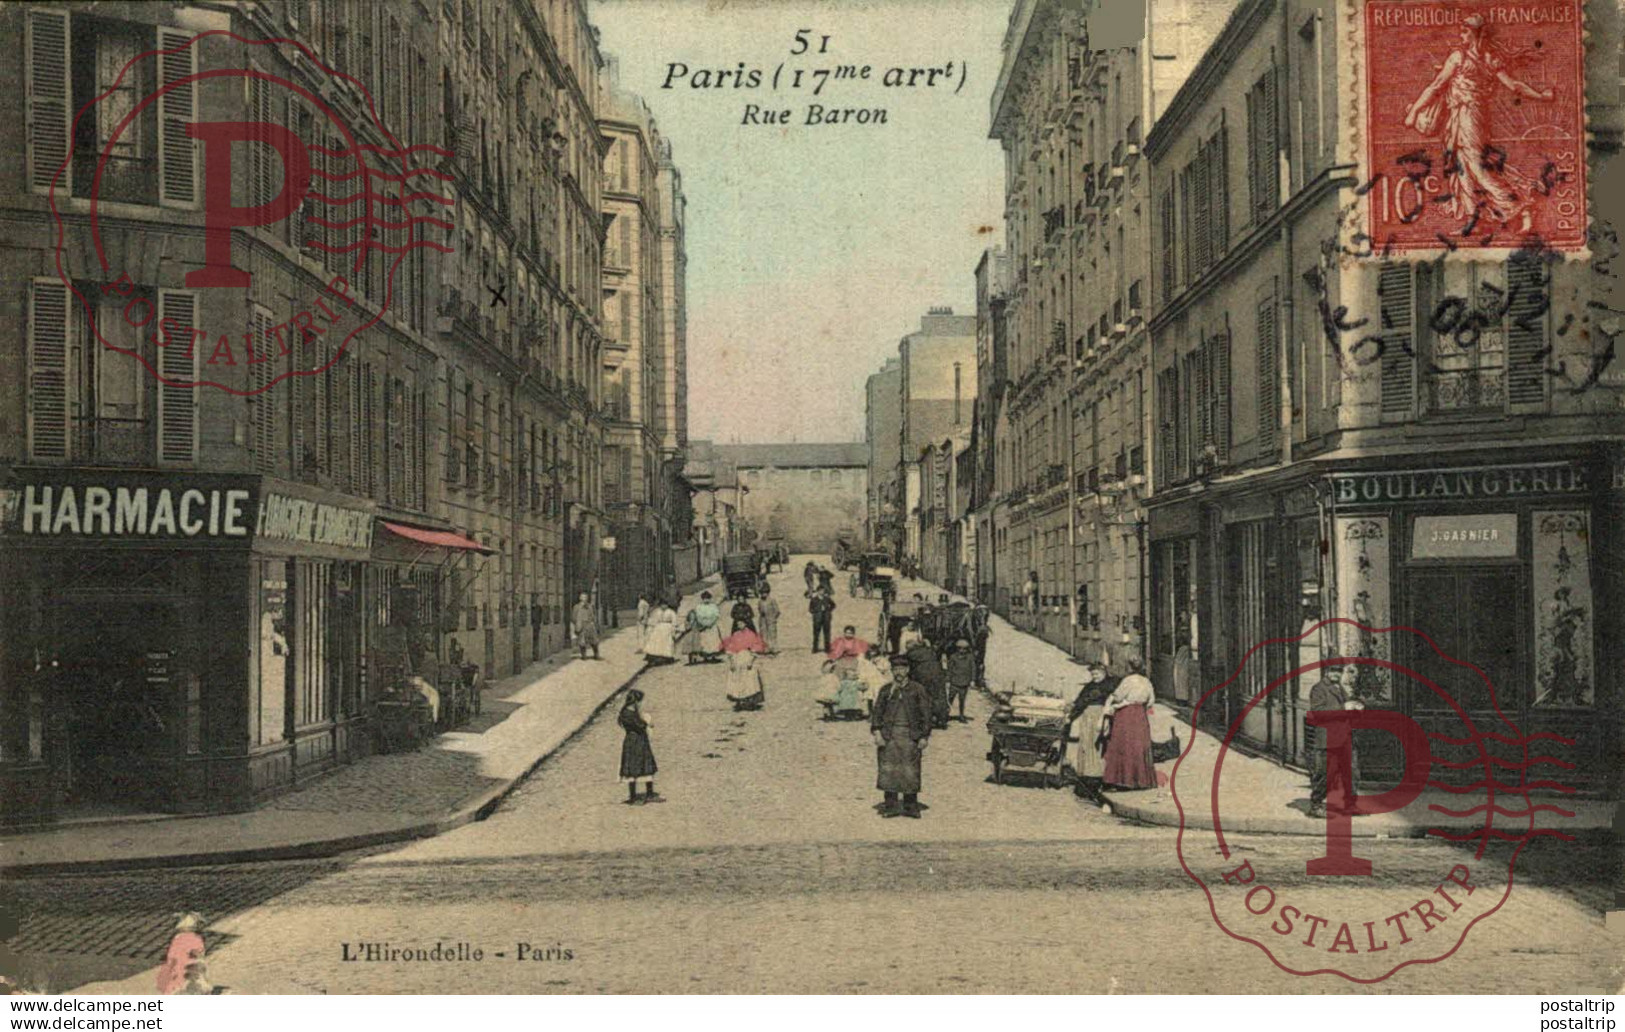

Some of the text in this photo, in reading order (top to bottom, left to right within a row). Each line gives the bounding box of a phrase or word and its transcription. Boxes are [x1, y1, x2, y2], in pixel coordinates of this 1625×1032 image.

[1556, 150, 1575, 231] POSTES
[1339, 465, 1588, 501] BOULANGERIE
[23, 485, 249, 535] HARMACIE
